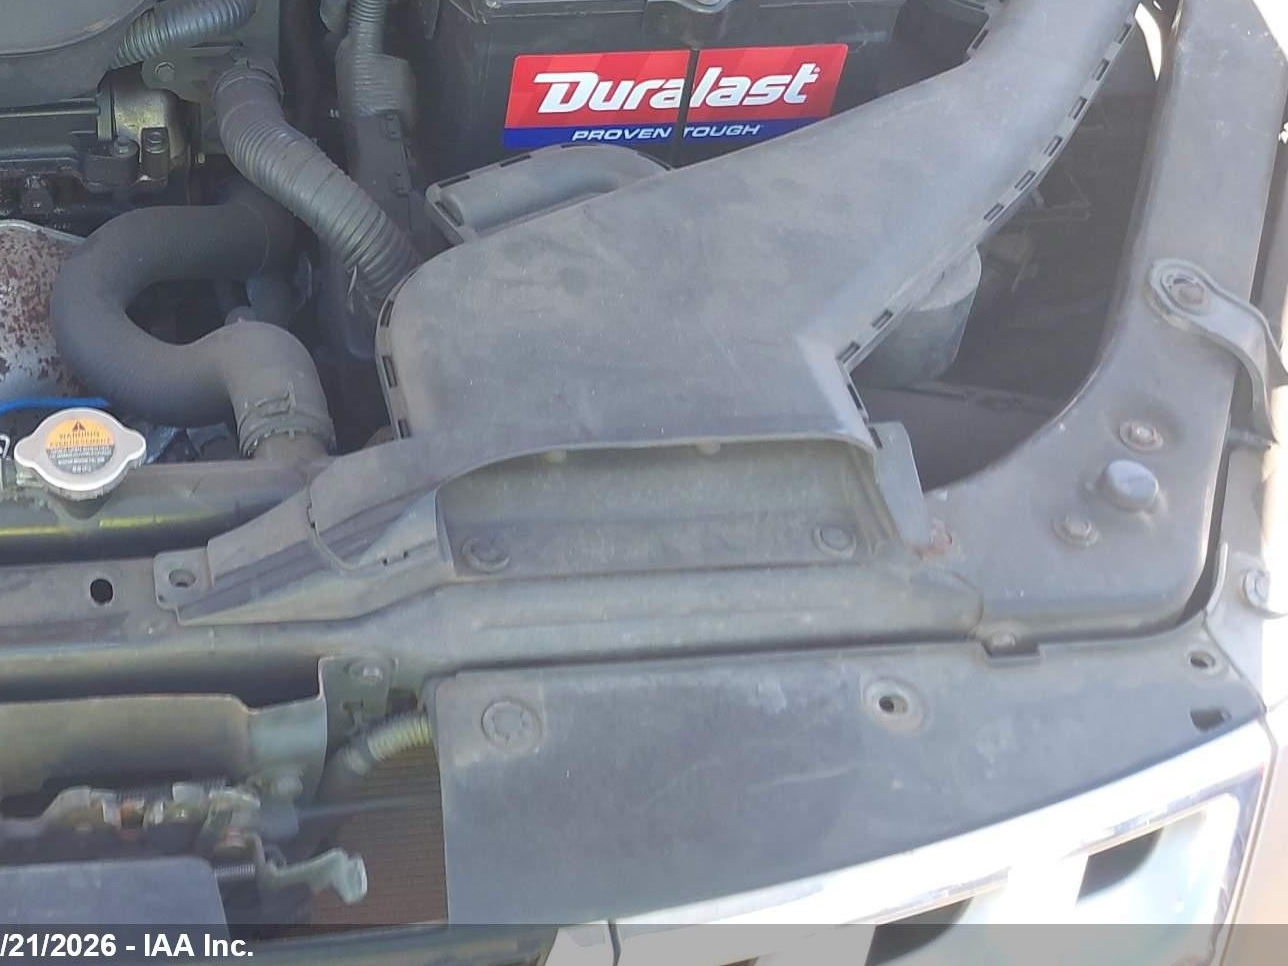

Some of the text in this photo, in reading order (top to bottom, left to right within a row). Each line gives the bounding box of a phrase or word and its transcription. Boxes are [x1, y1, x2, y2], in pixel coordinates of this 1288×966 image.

[533, 62, 820, 113] Duralast
[572, 124, 761, 141] PROVEN TOUGH
